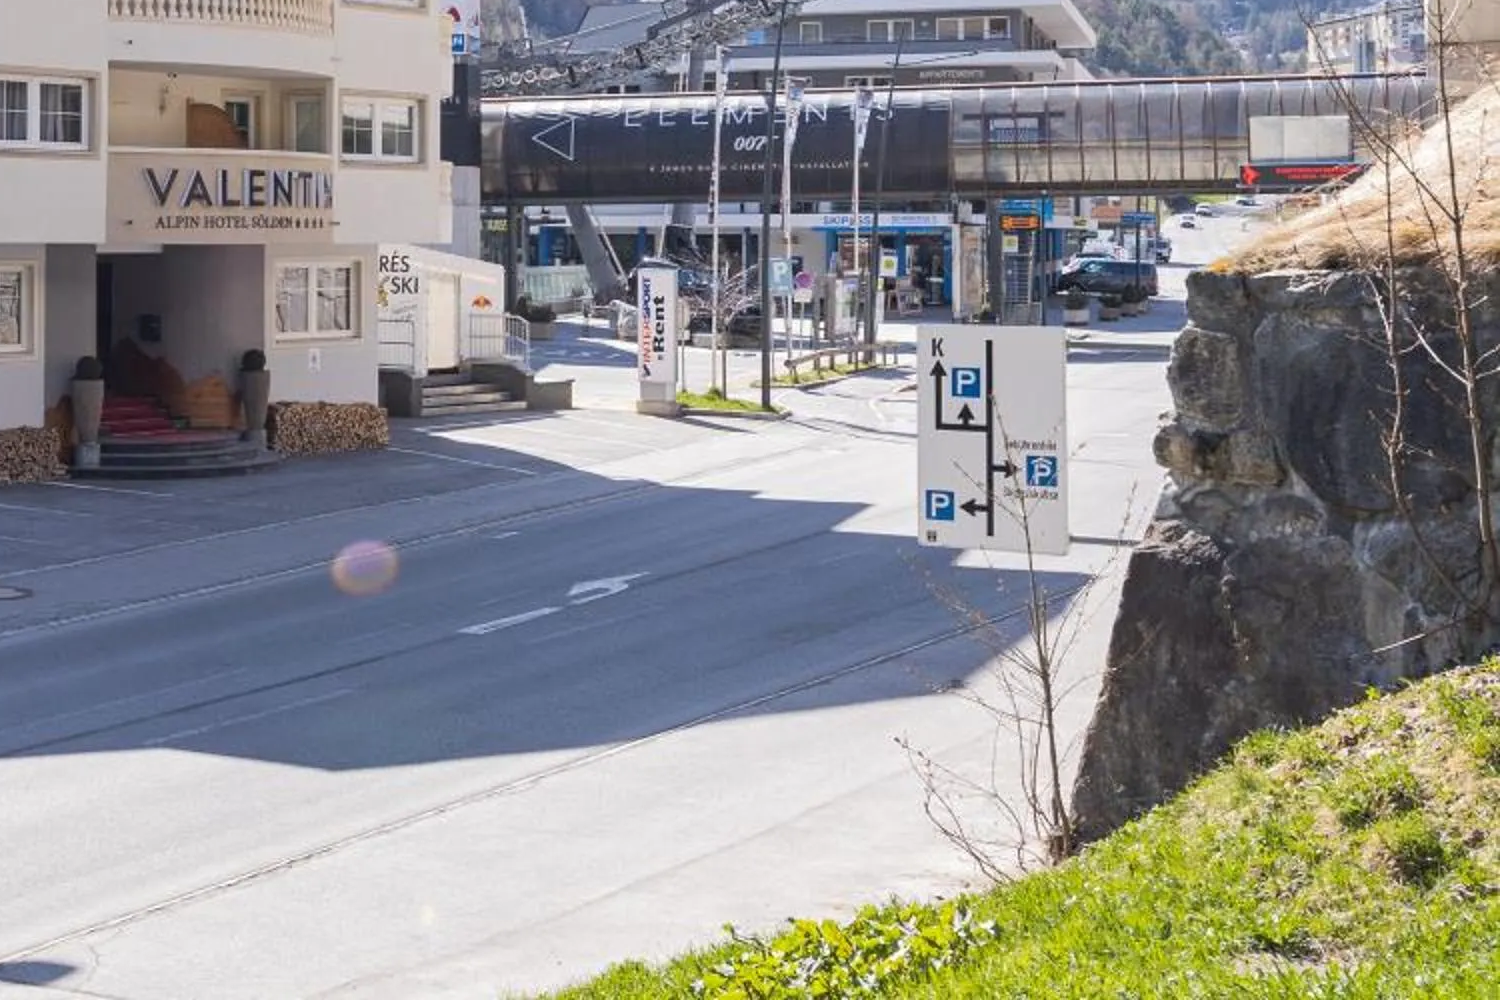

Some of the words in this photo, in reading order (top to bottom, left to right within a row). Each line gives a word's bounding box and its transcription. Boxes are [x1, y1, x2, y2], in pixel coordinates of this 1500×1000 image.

[733, 135, 768, 151] 007
[155, 215, 200, 229] ALPIN
[204, 215, 250, 229] HOTEL
[251, 213, 293, 229] SÖLDEN
[379, 250, 410, 273] RÉS
[773, 261, 788, 283] P
[932, 338, 944, 357] K
[956, 370, 976, 396] P
[1034, 464, 1051, 485] P
[931, 493, 949, 517] P
